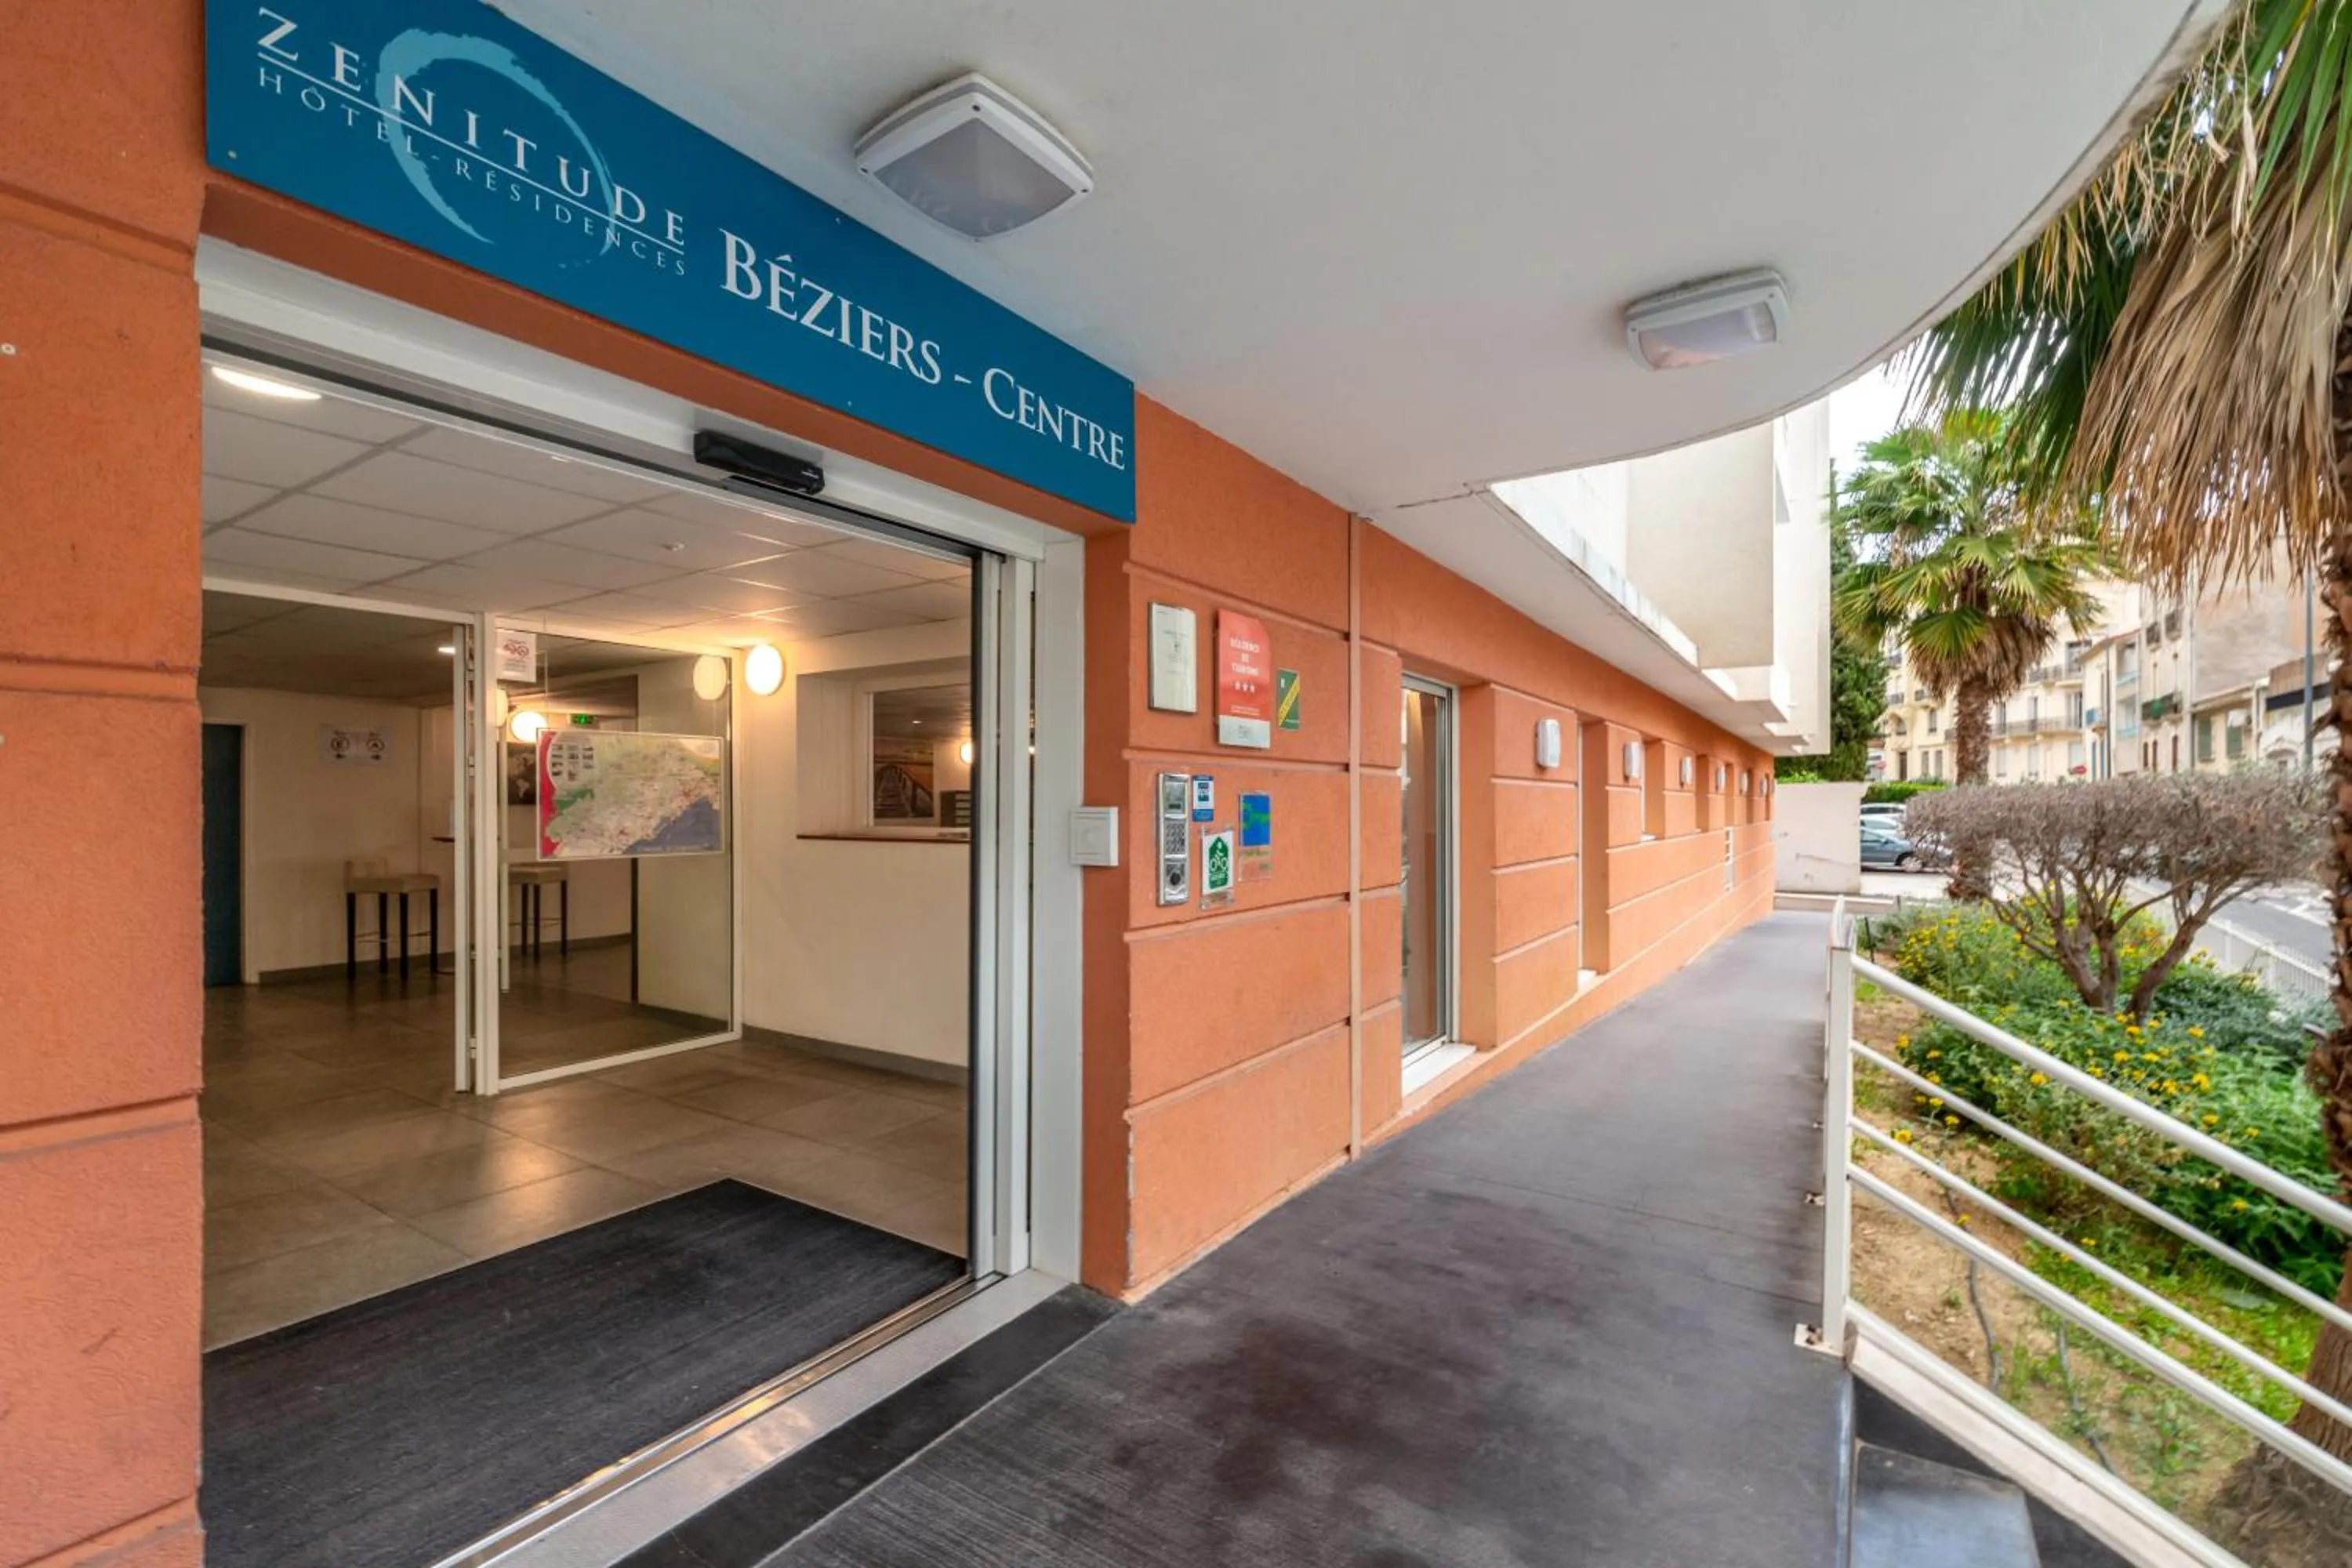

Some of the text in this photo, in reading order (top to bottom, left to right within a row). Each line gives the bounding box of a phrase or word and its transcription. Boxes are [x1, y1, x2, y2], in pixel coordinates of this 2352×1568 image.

[257, 7, 685, 246] ZENITUDE
[719, 228, 941, 385] BÉZIERS
[983, 367, 1125, 470] CENTRE
